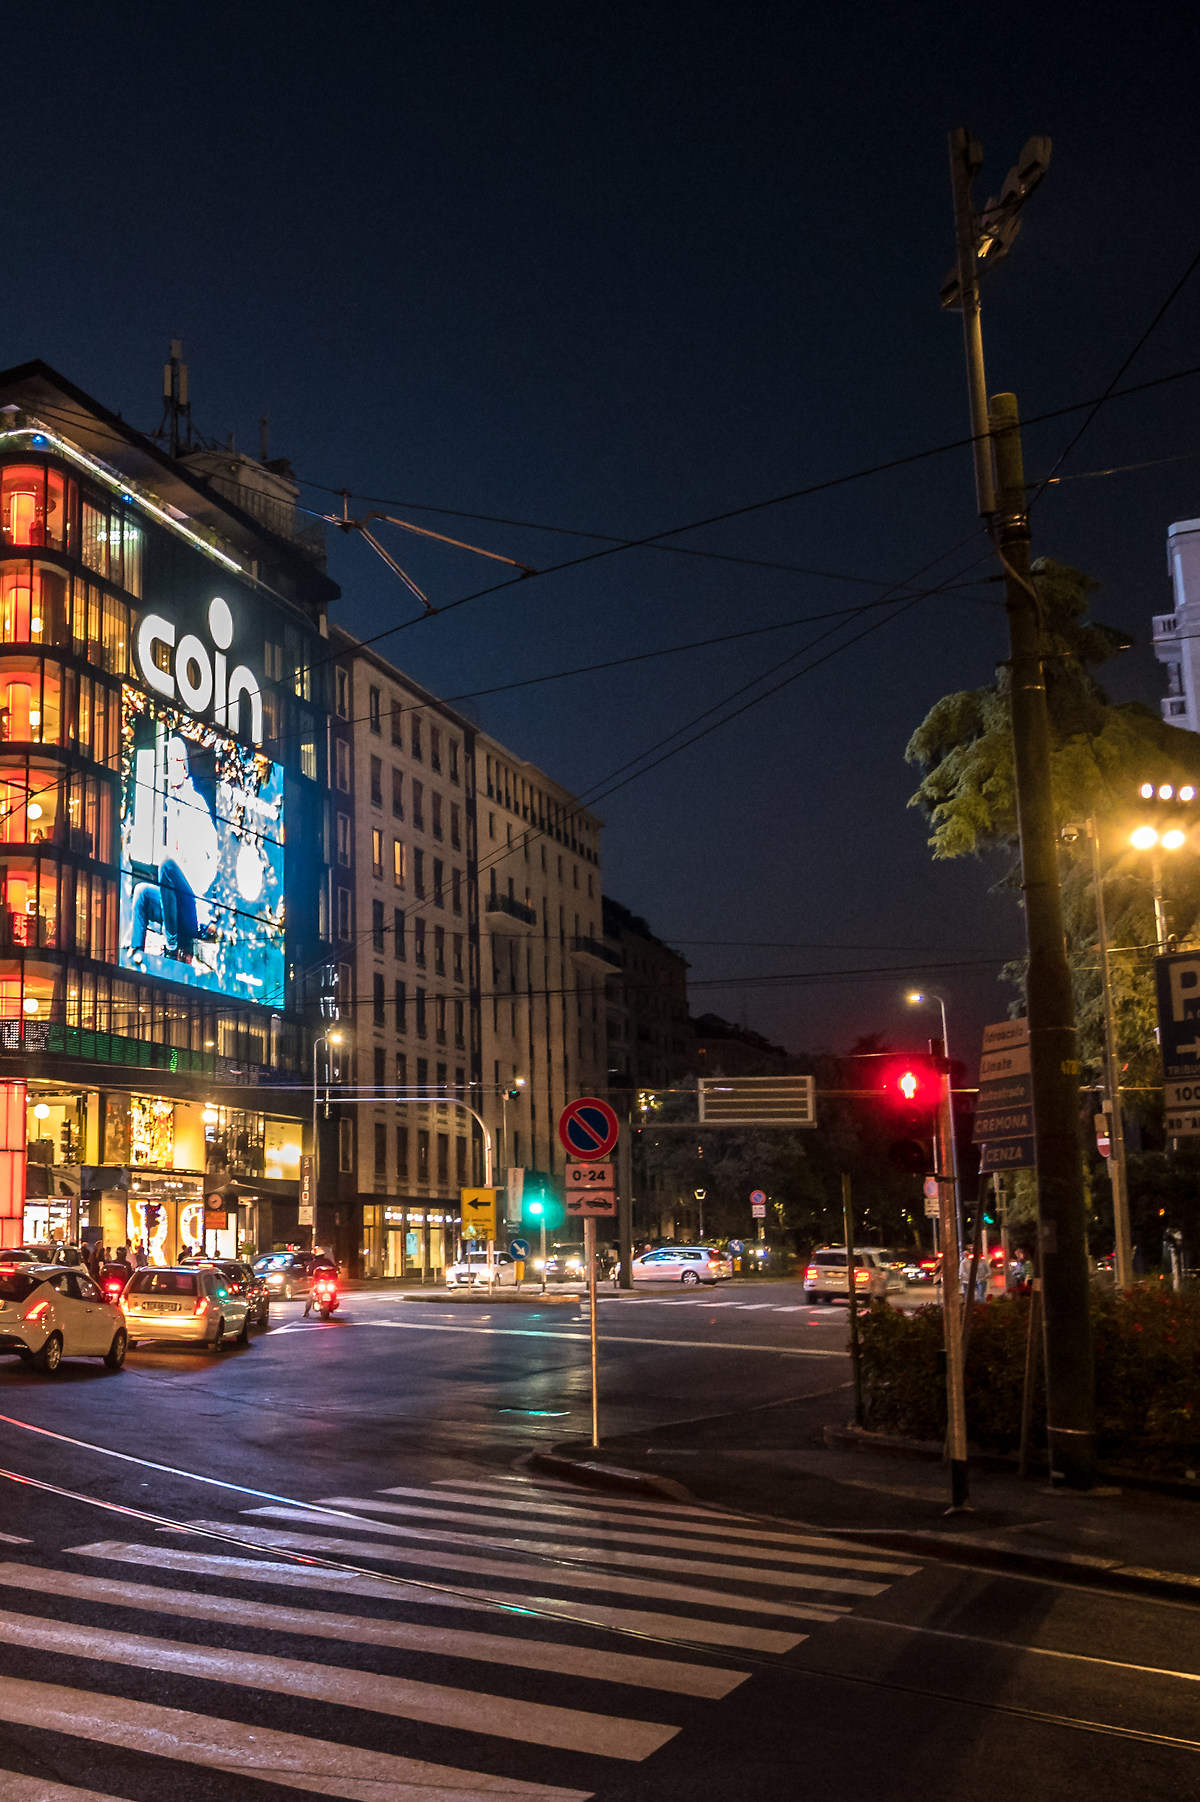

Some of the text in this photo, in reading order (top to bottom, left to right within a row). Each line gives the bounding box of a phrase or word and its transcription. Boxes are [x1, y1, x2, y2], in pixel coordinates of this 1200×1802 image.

[137, 597, 263, 748] coin
[975, 1113, 1029, 1133] CREMONA
[983, 1146, 1022, 1163] CENZA
[572, 1170, 606, 1182] 0-24
